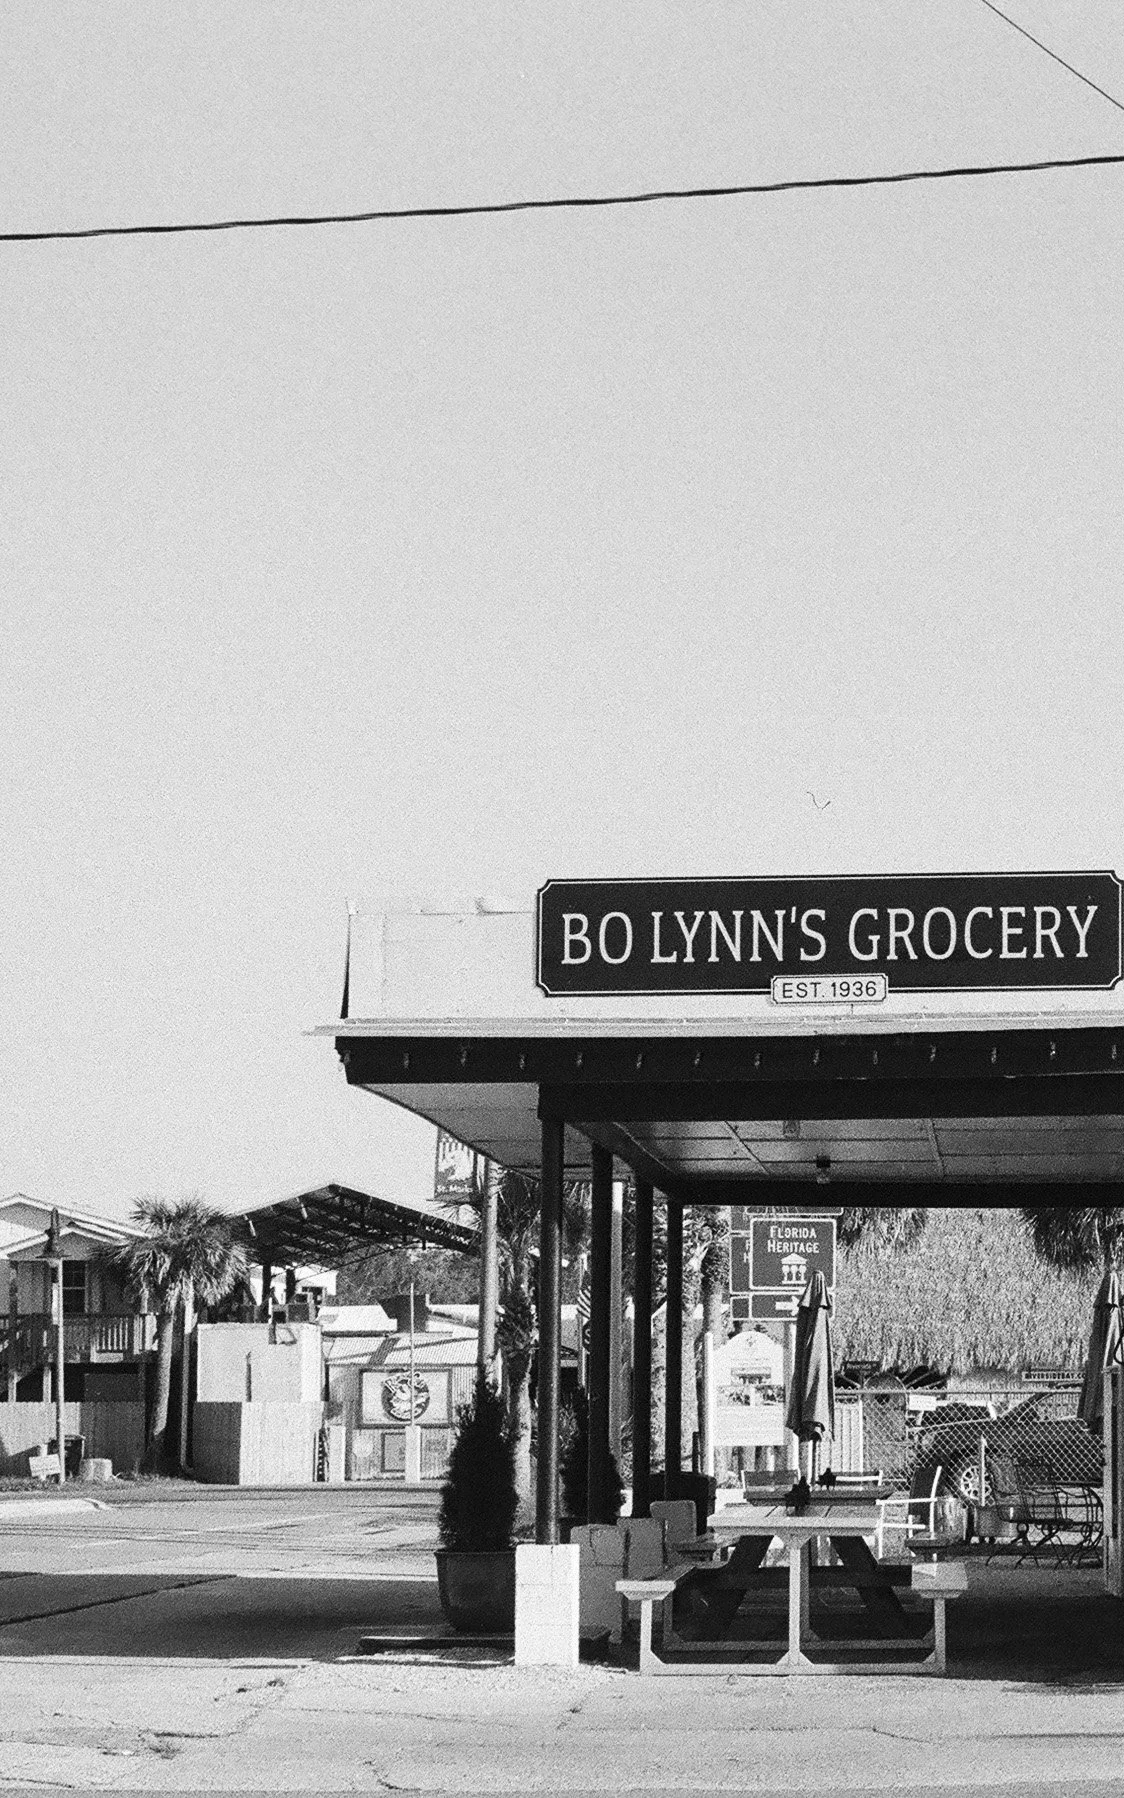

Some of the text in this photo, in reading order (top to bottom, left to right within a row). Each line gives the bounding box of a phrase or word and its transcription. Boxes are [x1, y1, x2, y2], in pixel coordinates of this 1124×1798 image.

[561, 905, 1099, 965] BO LYNN'S GROCERY
[782, 981, 877, 999] EST. 1936
[769, 1225, 818, 1239] FLORIDA
[767, 1240, 820, 1253] HERITAGE
